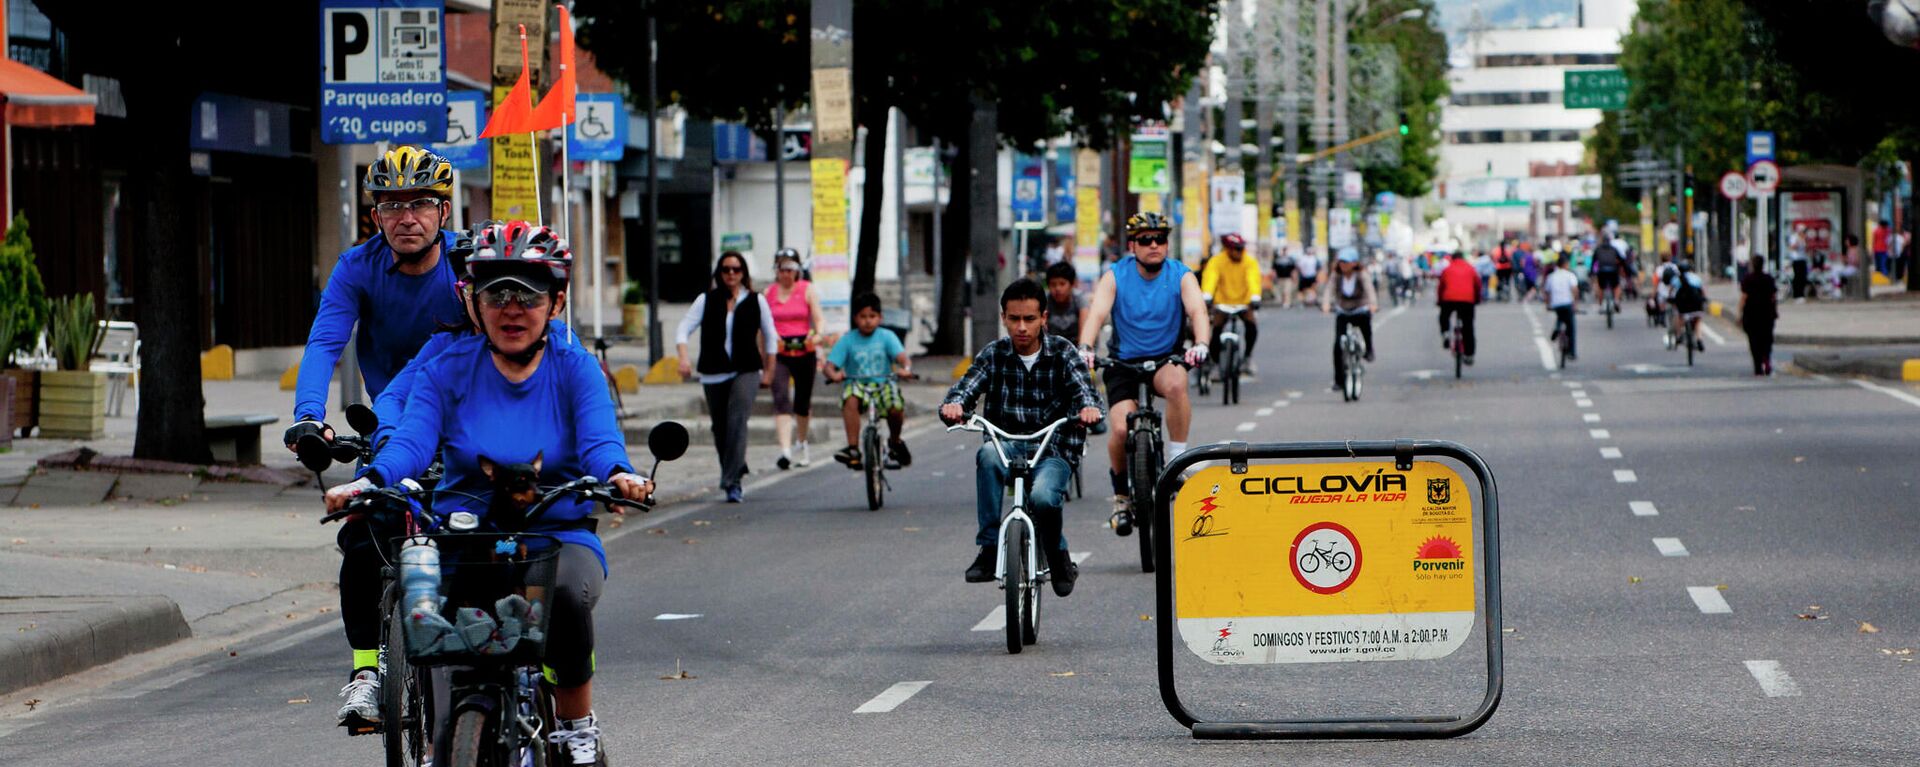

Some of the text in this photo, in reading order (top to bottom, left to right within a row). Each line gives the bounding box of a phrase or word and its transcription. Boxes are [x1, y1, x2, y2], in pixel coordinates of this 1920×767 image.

[332, 12, 369, 81] P
[324, 88, 444, 110] Parqueadero
[329, 116, 427, 137] 20 cupos
[1240, 468, 1407, 495] CICLOVÍA
[1289, 492, 1407, 504] RUEDA LA VIDA
[1413, 558, 1465, 571] Porvenir
[1433, 572, 1447, 580] hay
[1253, 632, 1304, 647] DOMINGOS
[1306, 632, 1313, 646] Y
